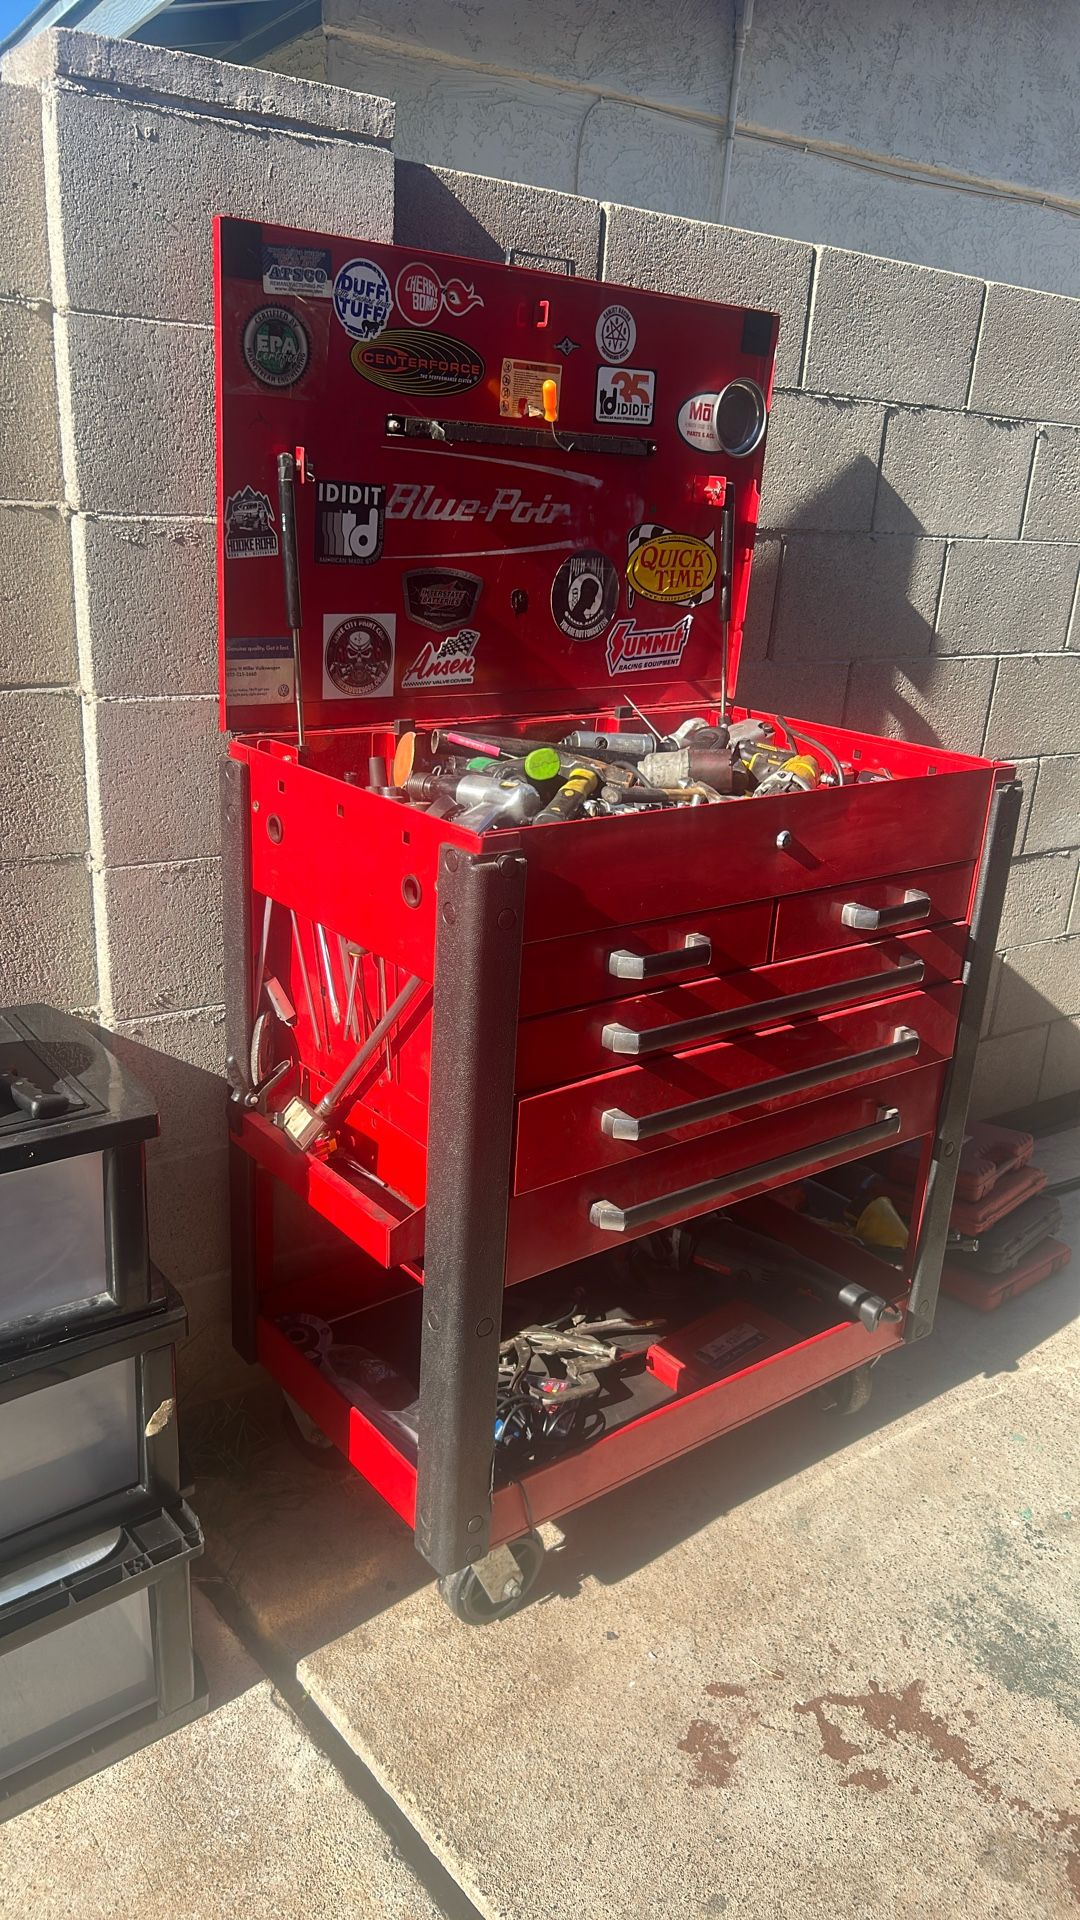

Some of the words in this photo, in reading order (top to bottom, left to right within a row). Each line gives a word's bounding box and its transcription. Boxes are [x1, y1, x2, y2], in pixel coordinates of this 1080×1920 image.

[340, 274, 386, 300] DUFF
[404, 275, 438, 298] CHERRY
[412, 292, 438, 312] BOMB
[254, 310, 289, 324] CERTIFIED
[257, 334, 297, 355] EPA
[363, 352, 481, 375] CENTERFORCE
[611, 371, 649, 404] 35
[617, 403, 650, 417] IDIDIT
[318, 482, 382, 506] IDIDIT
[255, 536, 277, 550] ROAD
[640, 546, 707, 571] QUICK
[655, 569, 704, 592] TIME
[420, 588, 466, 599] INTERSTATE
[421, 596, 460, 606] BATTERIES
[560, 619, 569, 632] YOU
[567, 626, 576, 637] ARE
[575, 629, 585, 638] NOT
[404, 643, 474, 682] Ansen
[619, 662, 643, 671] RACING
[643, 658, 680, 668] EQUIPMENT
